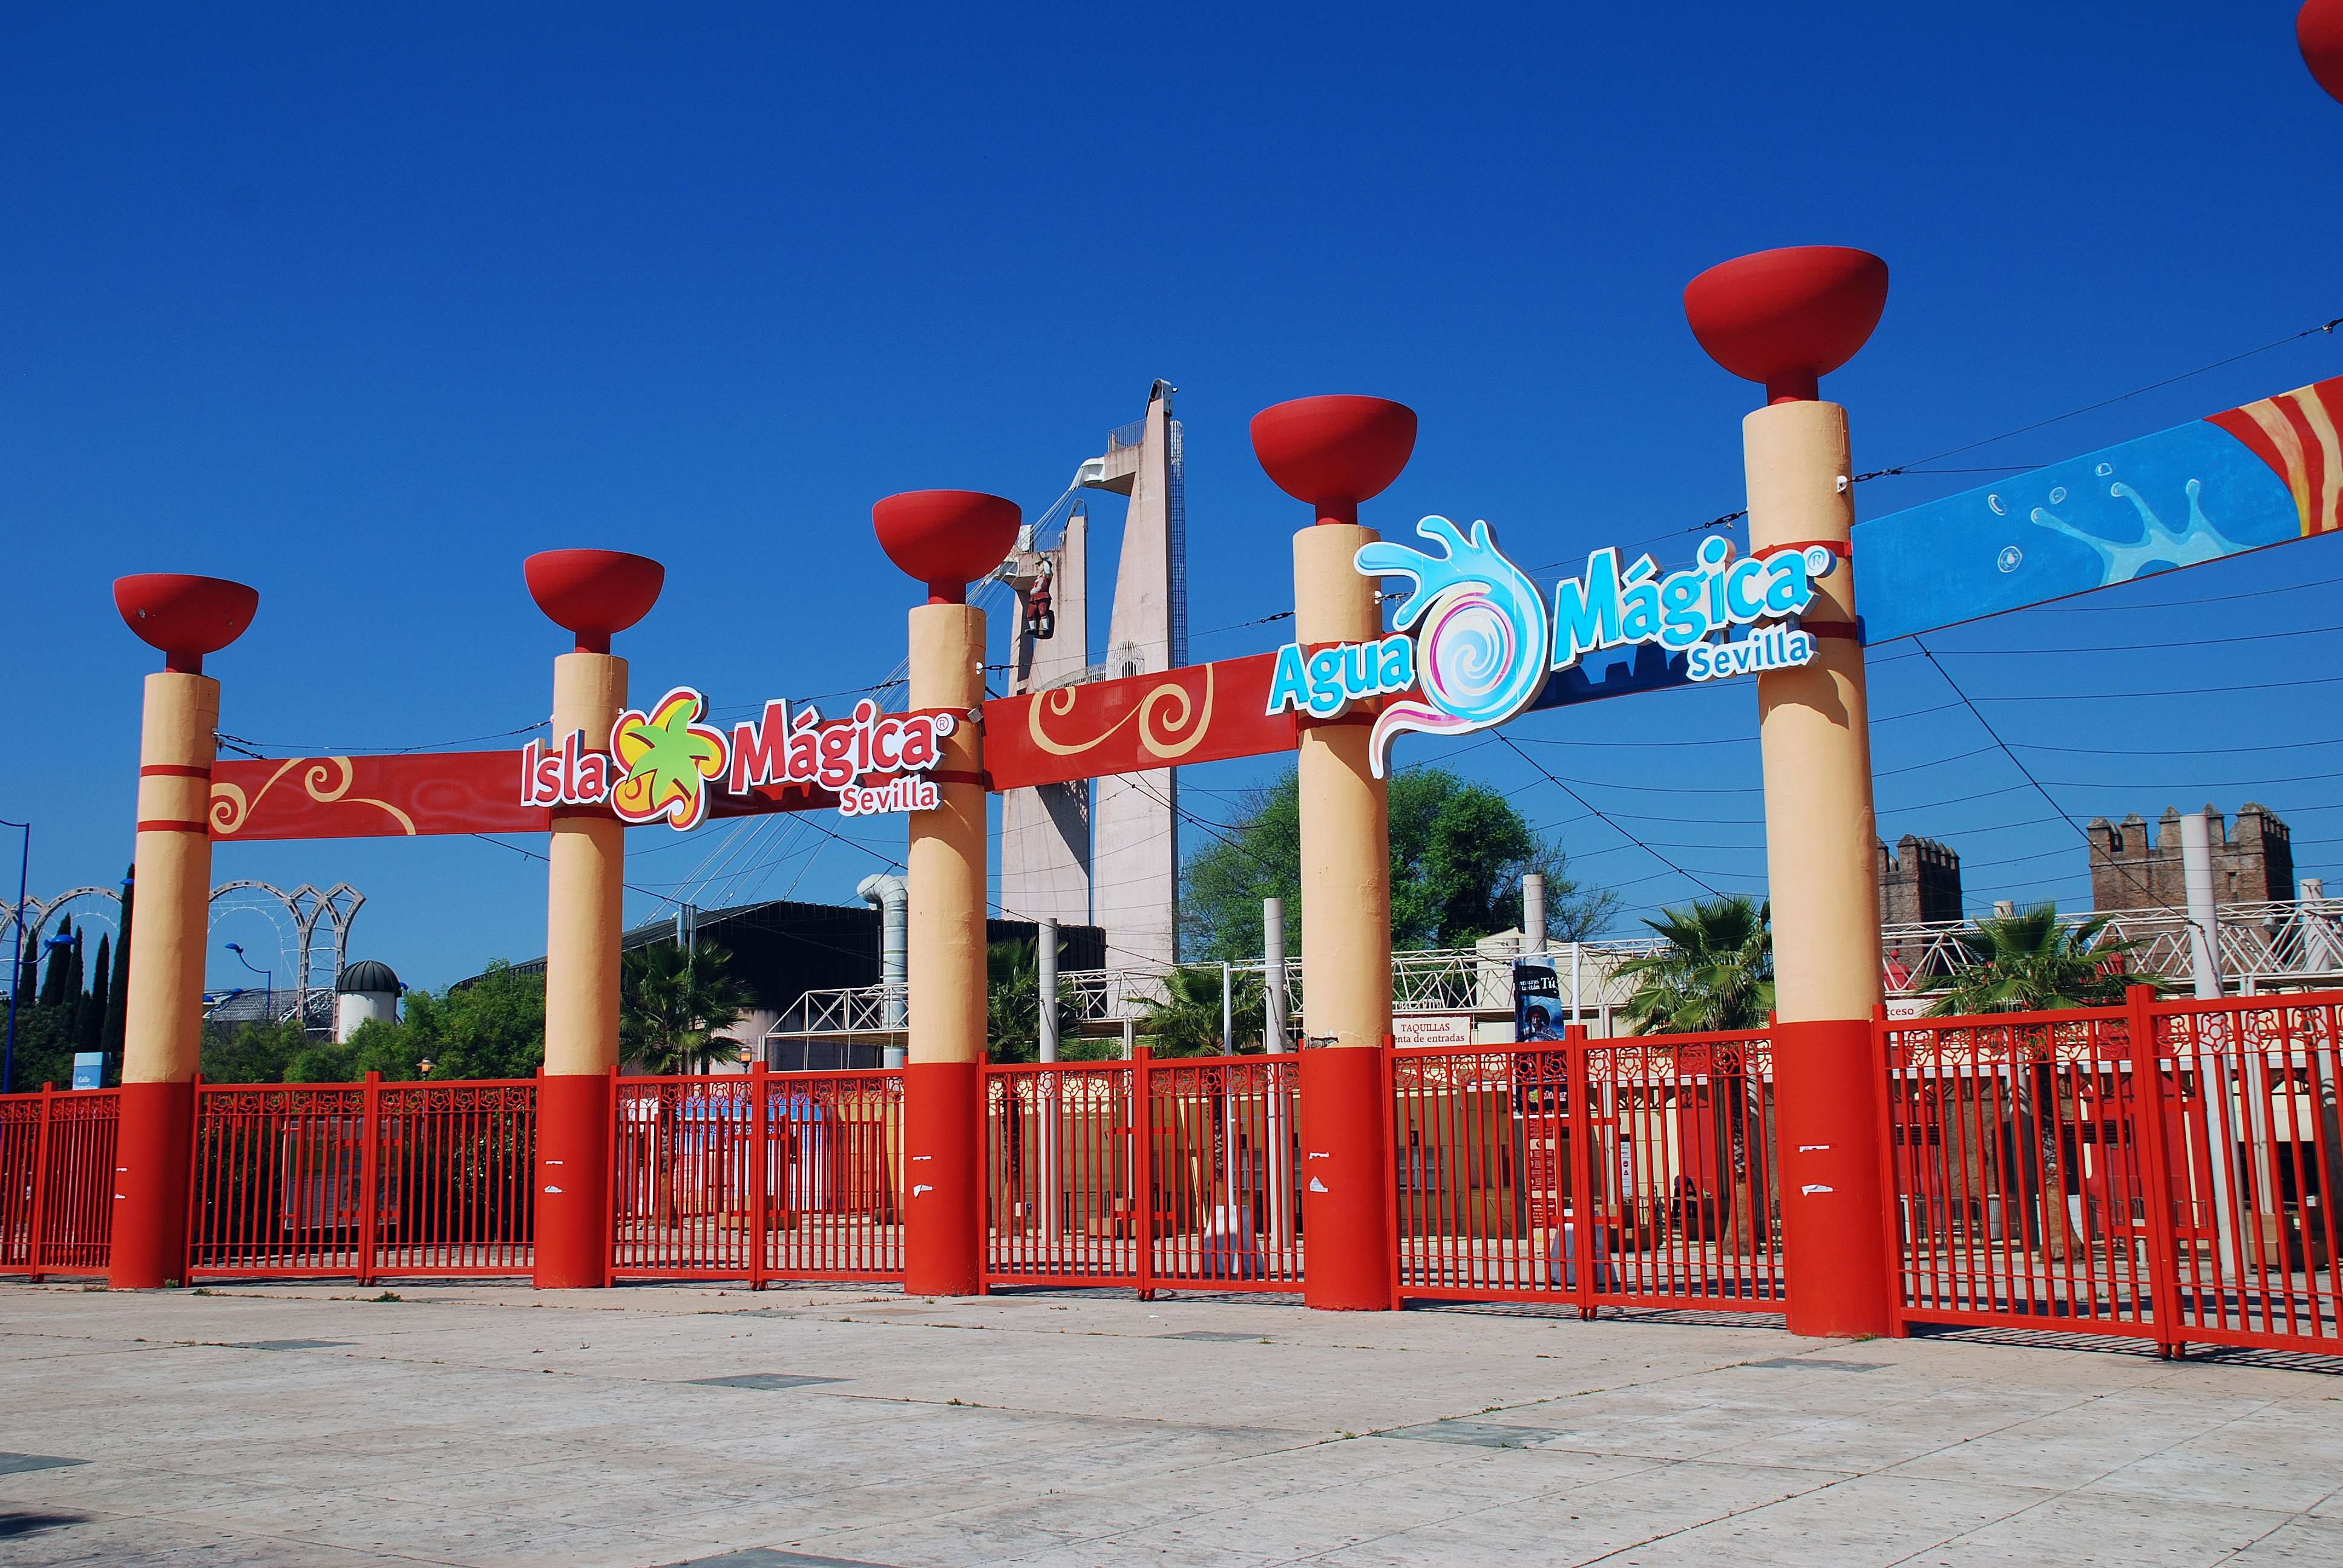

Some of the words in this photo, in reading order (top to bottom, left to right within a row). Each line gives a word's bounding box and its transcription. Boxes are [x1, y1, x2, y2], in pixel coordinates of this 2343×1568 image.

[1269, 636, 1414, 713] Agua
[1690, 632, 1809, 678] Sevilla
[523, 732, 606, 804] Isla
[842, 780, 936, 812] Sevilla
[1395, 1034, 1411, 1043] enta
[1414, 1033, 1424, 1042] de
[1427, 1033, 1465, 1042] entradas
[1401, 1023, 1450, 1034] TAQUILLAS
